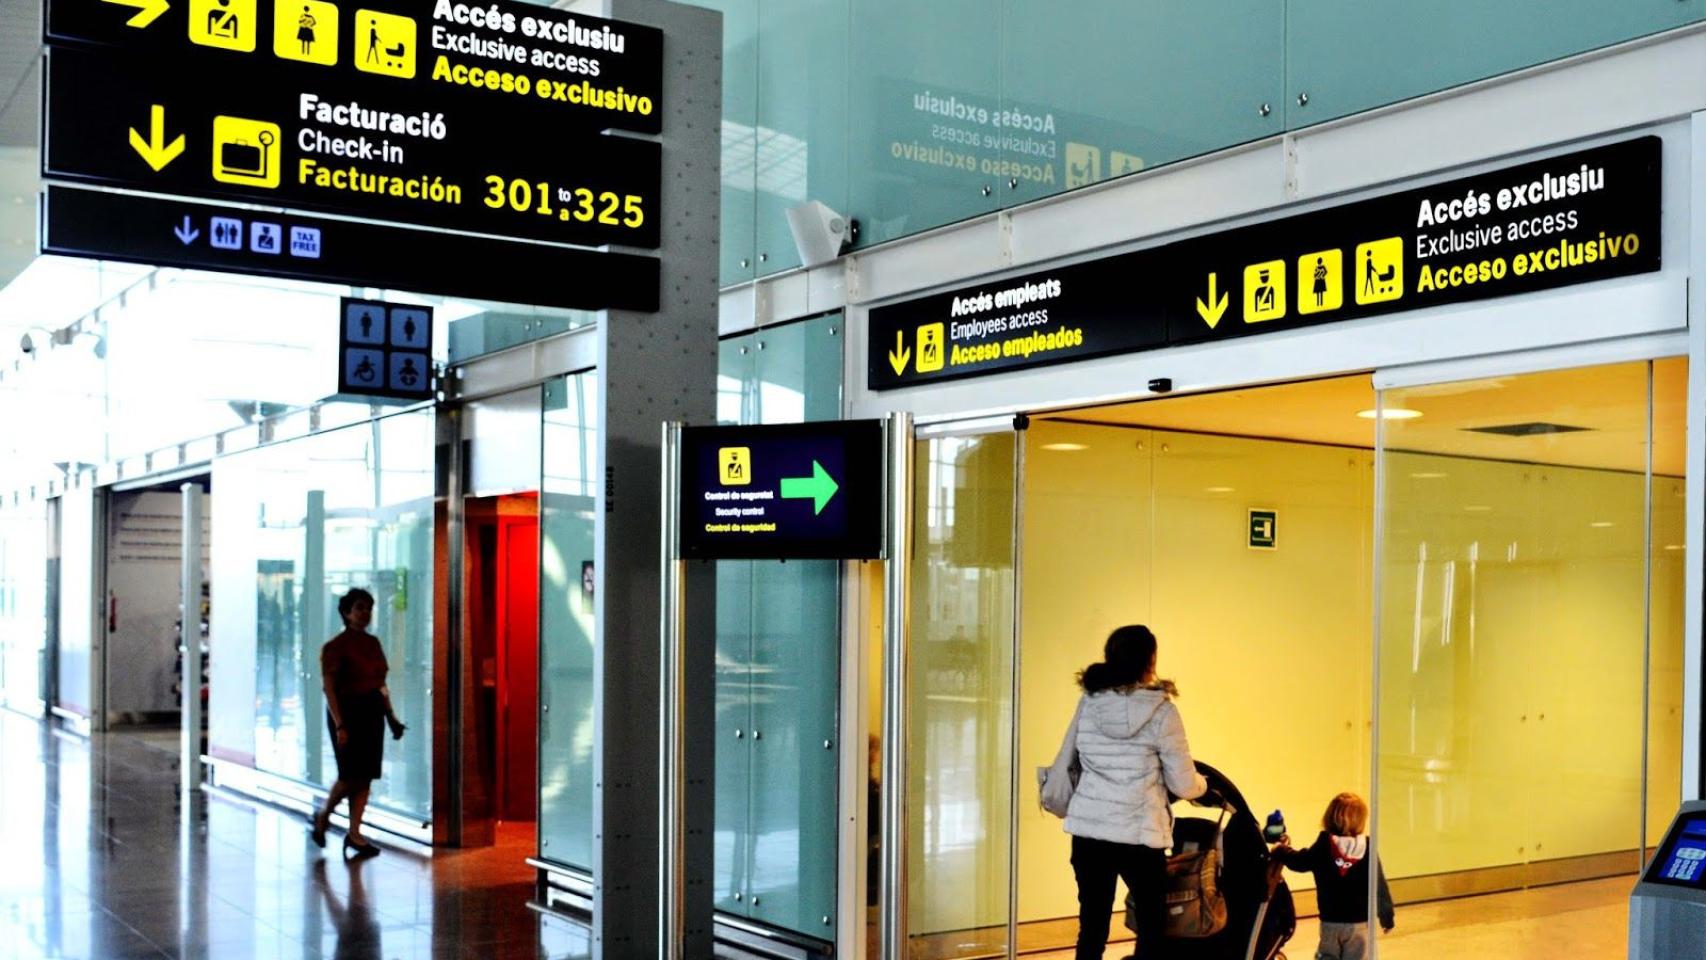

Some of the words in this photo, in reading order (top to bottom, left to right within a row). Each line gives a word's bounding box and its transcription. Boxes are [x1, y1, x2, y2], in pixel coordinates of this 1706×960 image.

[433, 0, 516, 33] Accés
[521, 16, 625, 54] exclusiu
[432, 25, 527, 63] Exclusive
[531, 48, 600, 76] access
[432, 55, 531, 95] Acceso
[536, 79, 652, 115] exclusivo
[299, 92, 446, 140] Facturació
[298, 128, 404, 164] Check-in
[299, 158, 461, 204] Facturación
[484, 175, 553, 215] 301
[558, 187, 572, 202] to
[573, 188, 644, 228] 325
[1417, 190, 1491, 228] Accés
[1497, 164, 1604, 211] exclusiu
[293, 241, 317, 252] FREE
[296, 232, 315, 242] TAX
[1416, 224, 1501, 259] Exclusive
[1507, 210, 1578, 242] access
[1417, 257, 1507, 293] Acceso
[1513, 231, 1639, 276] exclusivo
[951, 291, 993, 317] Accés
[994, 278, 1062, 309] empleats
[950, 342, 1000, 366] Acceso
[1002, 325, 1083, 358] empleados
[951, 317, 1007, 341] Employees
[1009, 309, 1048, 330] access
[704, 491, 730, 501] Control
[715, 507, 741, 518] Security
[741, 506, 765, 516] control
[705, 523, 731, 533] Control
